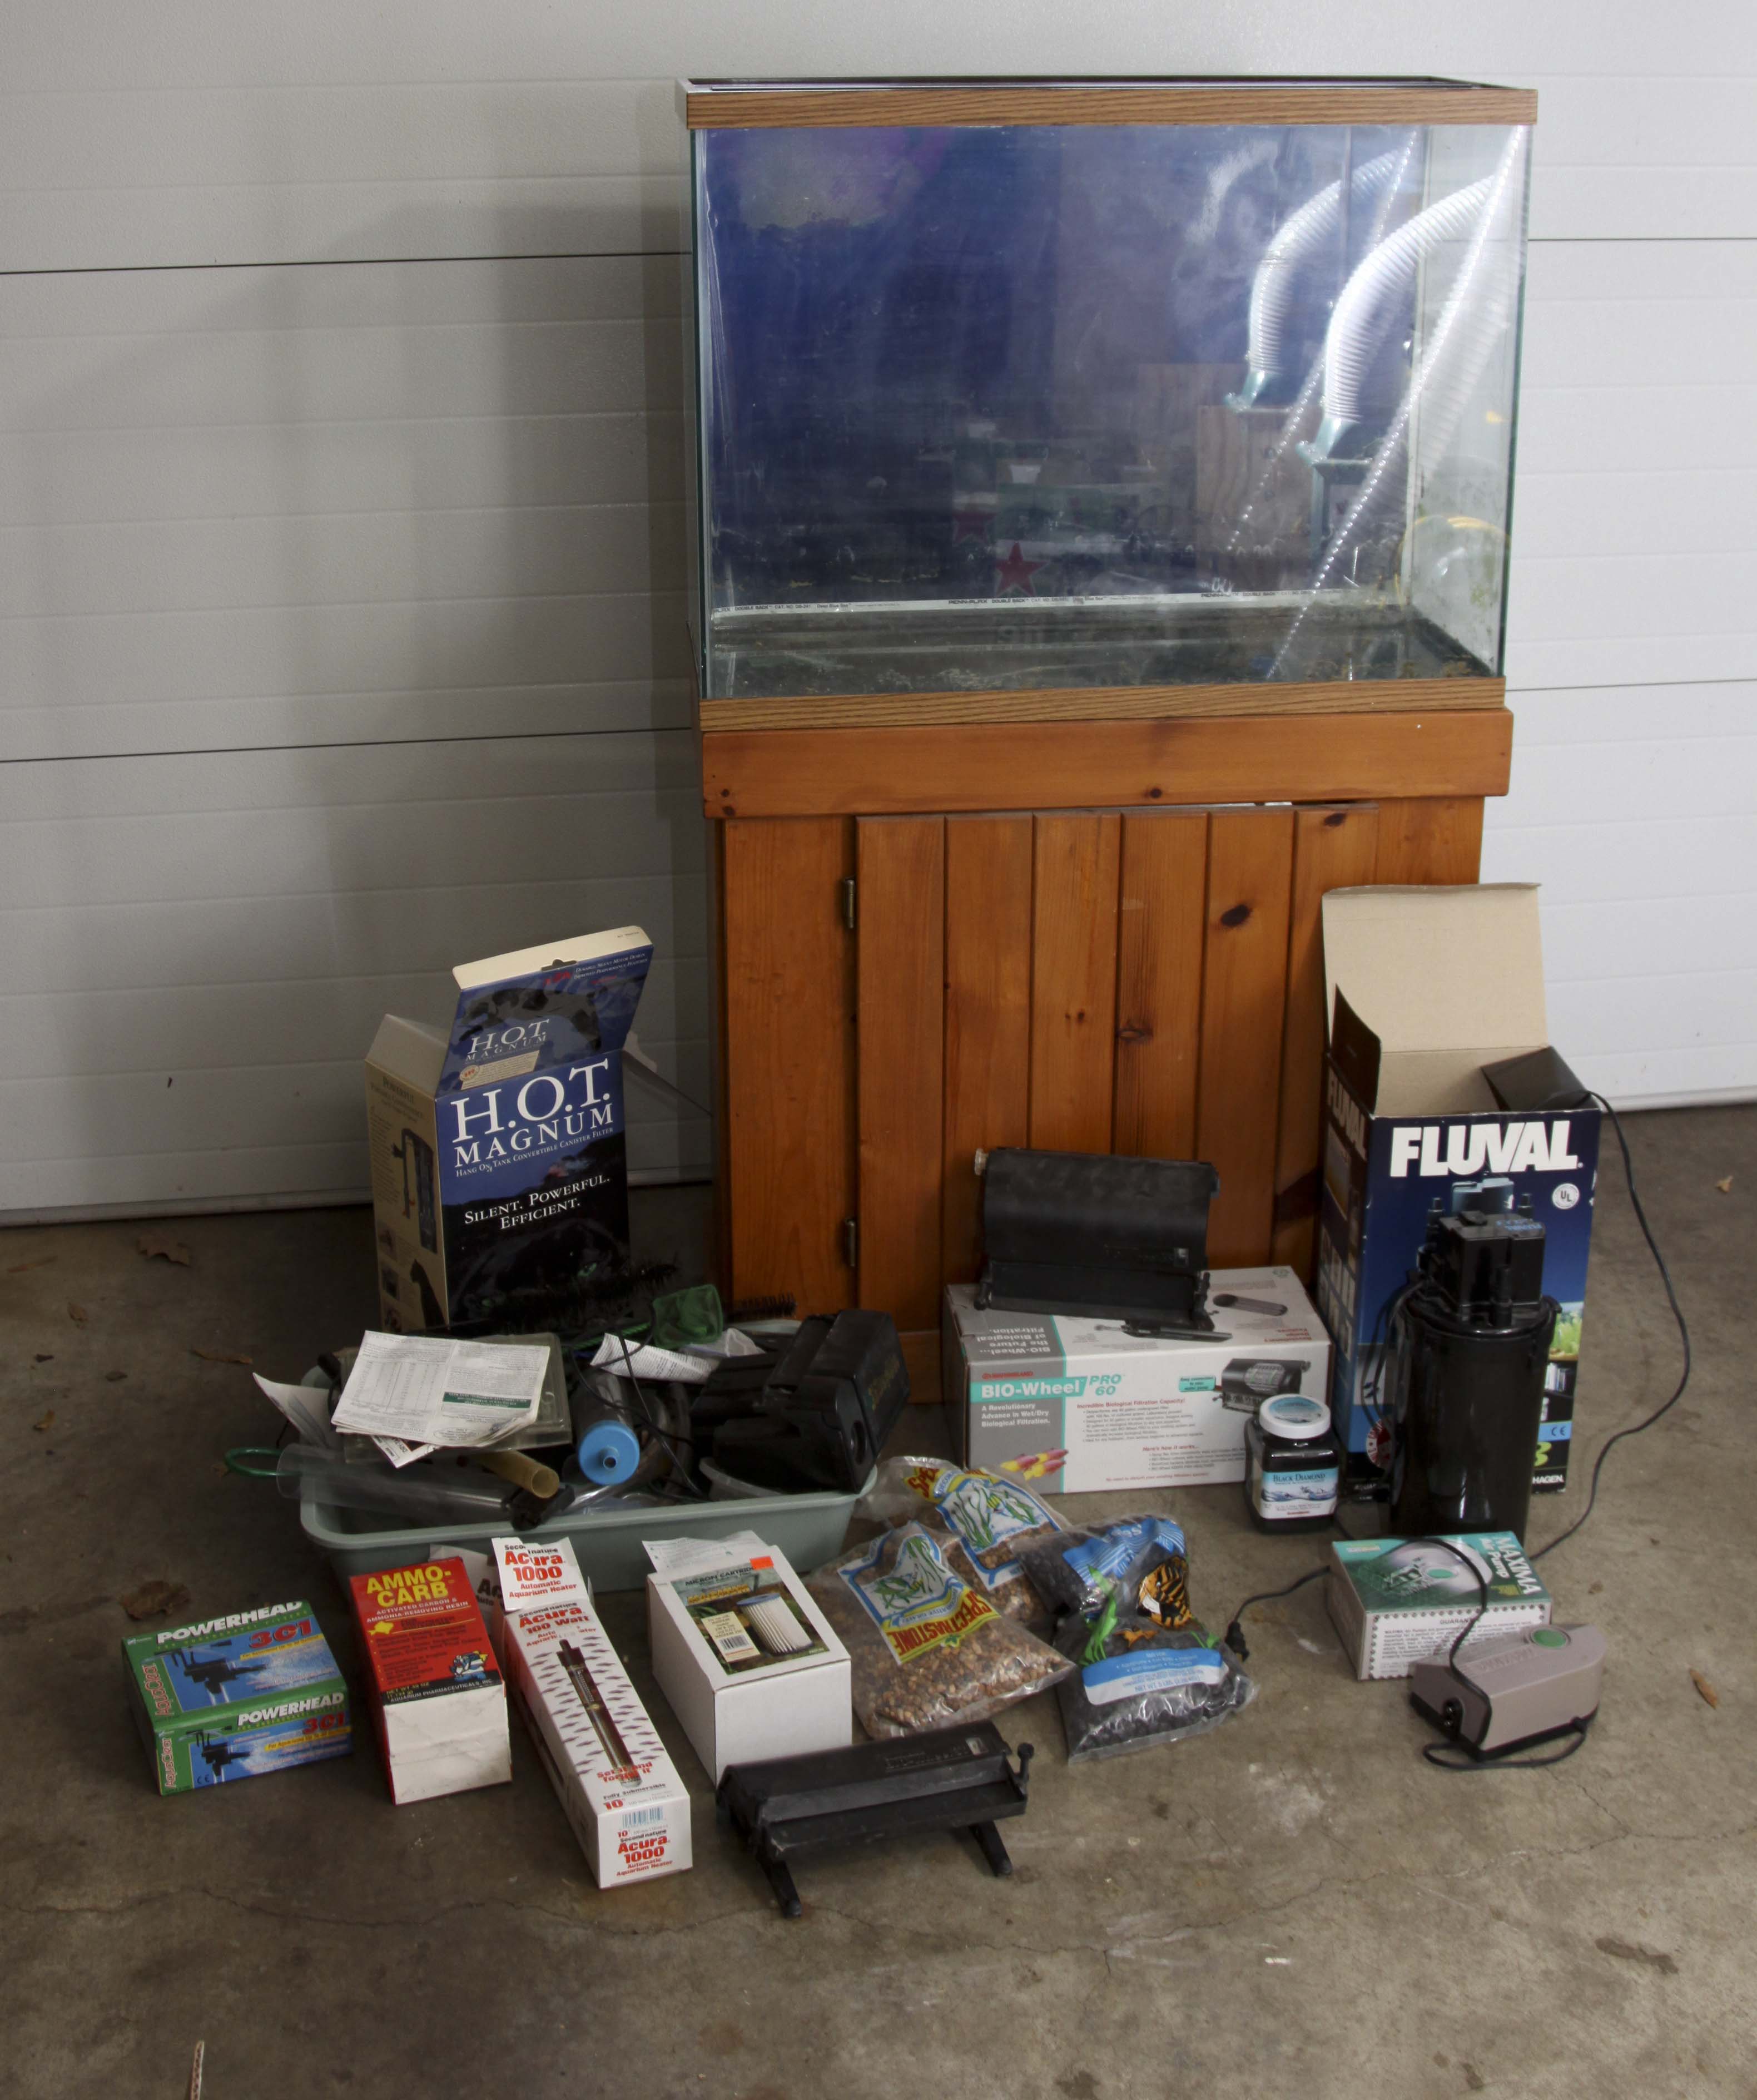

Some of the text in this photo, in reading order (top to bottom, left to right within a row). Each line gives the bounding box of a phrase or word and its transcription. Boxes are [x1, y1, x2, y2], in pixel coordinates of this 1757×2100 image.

[468, 1019, 550, 1054] H.O.T.
[466, 1034, 547, 1062] MAGNUM
[450, 1058, 611, 1143] H.O.T.
[454, 1103, 614, 1168] MAGNUM
[456, 1167, 478, 1178] HANG
[492, 1157, 511, 1168] TANK
[513, 1145, 558, 1162] CONVERTIBLE
[559, 1134, 591, 1149] CANISTER
[592, 1127, 614, 1138] FILTER
[1390, 1120, 1578, 1177] FLUVAL
[464, 1174, 611, 1225] SILENT. POWERFUL.
[1560, 1190, 1572, 1202] UL
[500, 1197, 580, 1230] EFFICIENT.
[981, 1374, 1121, 1399] BIO-Wheel PRO
[1094, 1385, 1116, 1396] 60
[989, 1403, 1036, 1411] Revolutionary
[1021, 1410, 1050, 1418] Wet/Dry
[981, 1418, 1050, 1428] Biological Filtration.
[1273, 1473, 1326, 1483] BLACK DIAMOND
[505, 1551, 563, 1566] Acura
[1488, 1551, 1511, 1578] Pump
[1495, 1537, 1542, 1594] MAXIMA
[366, 1566, 452, 1595] AMMO-
[513, 1566, 563, 1582] 1000
[685, 1574, 718, 1586] MICRON
[376, 1581, 449, 1608] CARB
[509, 1588, 548, 1598] Aquarium
[550, 1583, 577, 1592] Heater
[520, 1579, 561, 1590] Automatic
[376, 1604, 418, 1615] ACTIVATED
[419, 1598, 450, 1609] CARBON
[445, 1601, 469, 1610] RESIN
[156, 1601, 303, 1644] POWERHEAD
[519, 1607, 583, 1628] Acura
[526, 1616, 590, 1635] 100 Watt
[886, 1591, 993, 1656] SPECTRASTONE
[249, 1619, 312, 1649] 301
[390, 1692, 423, 1703] AQUARIUM
[237, 1692, 345, 1727] POWERHEAD
[302, 1711, 345, 1735] 301
[617, 1835, 668, 1855] Acura
[620, 1833, 644, 1843] Second
[624, 1845, 664, 1864] 1000
[627, 1858, 662, 1869] Automatic
[616, 1860, 673, 1876] Aquarium Heater
